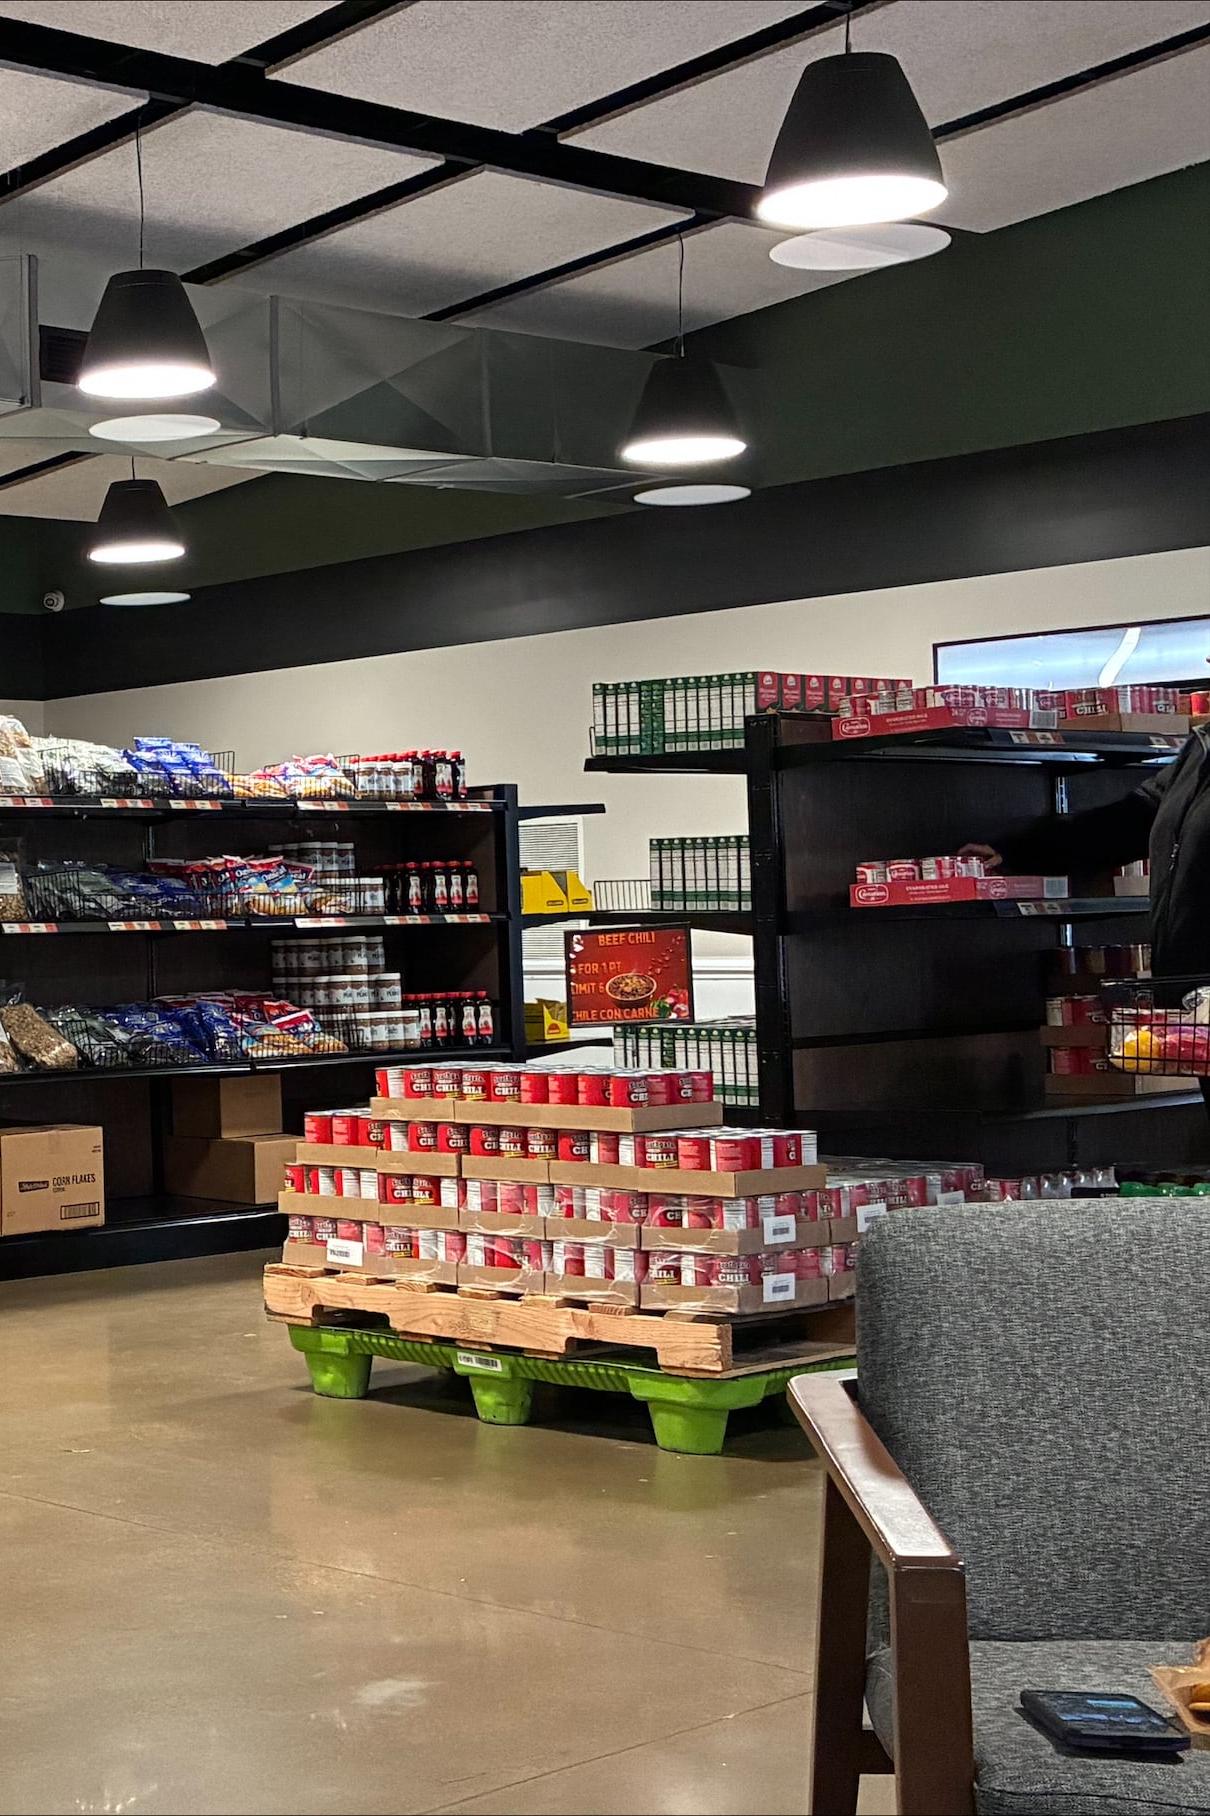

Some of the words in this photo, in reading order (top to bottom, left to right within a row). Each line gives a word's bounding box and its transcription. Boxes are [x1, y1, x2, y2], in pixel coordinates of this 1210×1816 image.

[598, 934, 626, 946] BEEF
[628, 931, 655, 944] CHILI
[578, 962, 599, 974] FOR
[599, 1008, 622, 1019] CON
[623, 1006, 660, 1019] CARNE
[435, 1084, 461, 1093] CHIL
[494, 1086, 521, 1096] CHIL
[52, 1175, 71, 1187] CORN
[71, 1173, 96, 1185] FLAKES
[718, 1273, 750, 1283] CHILI
